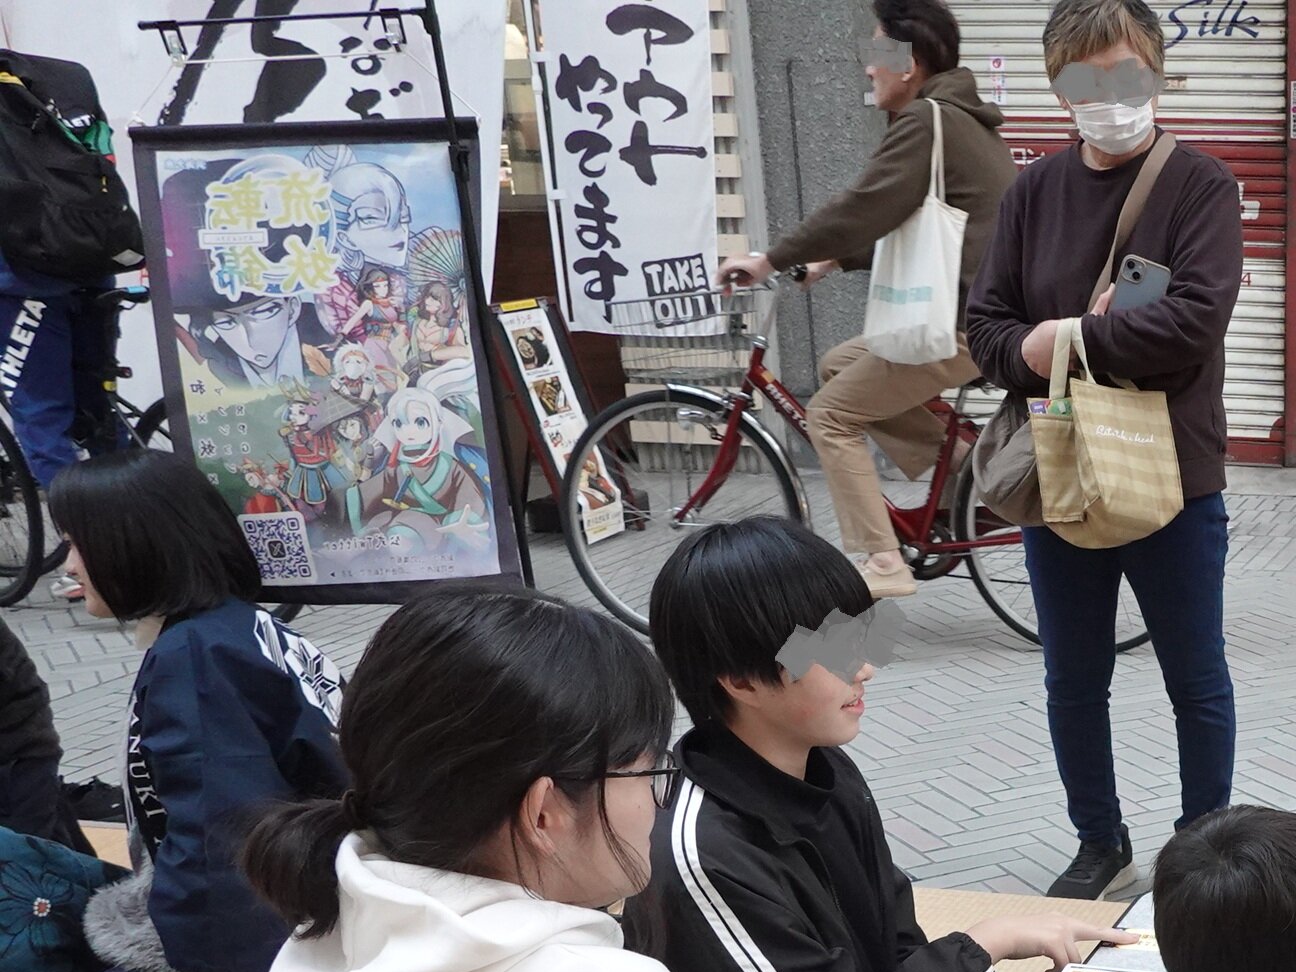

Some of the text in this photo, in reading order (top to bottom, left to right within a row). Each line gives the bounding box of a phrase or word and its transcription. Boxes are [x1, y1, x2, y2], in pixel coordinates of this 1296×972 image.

[1163, 0, 1261, 49] Silk
[555, 53, 628, 324] やってます
[643, 256, 707, 294] TAKE
[654, 294, 708, 325] OUT
